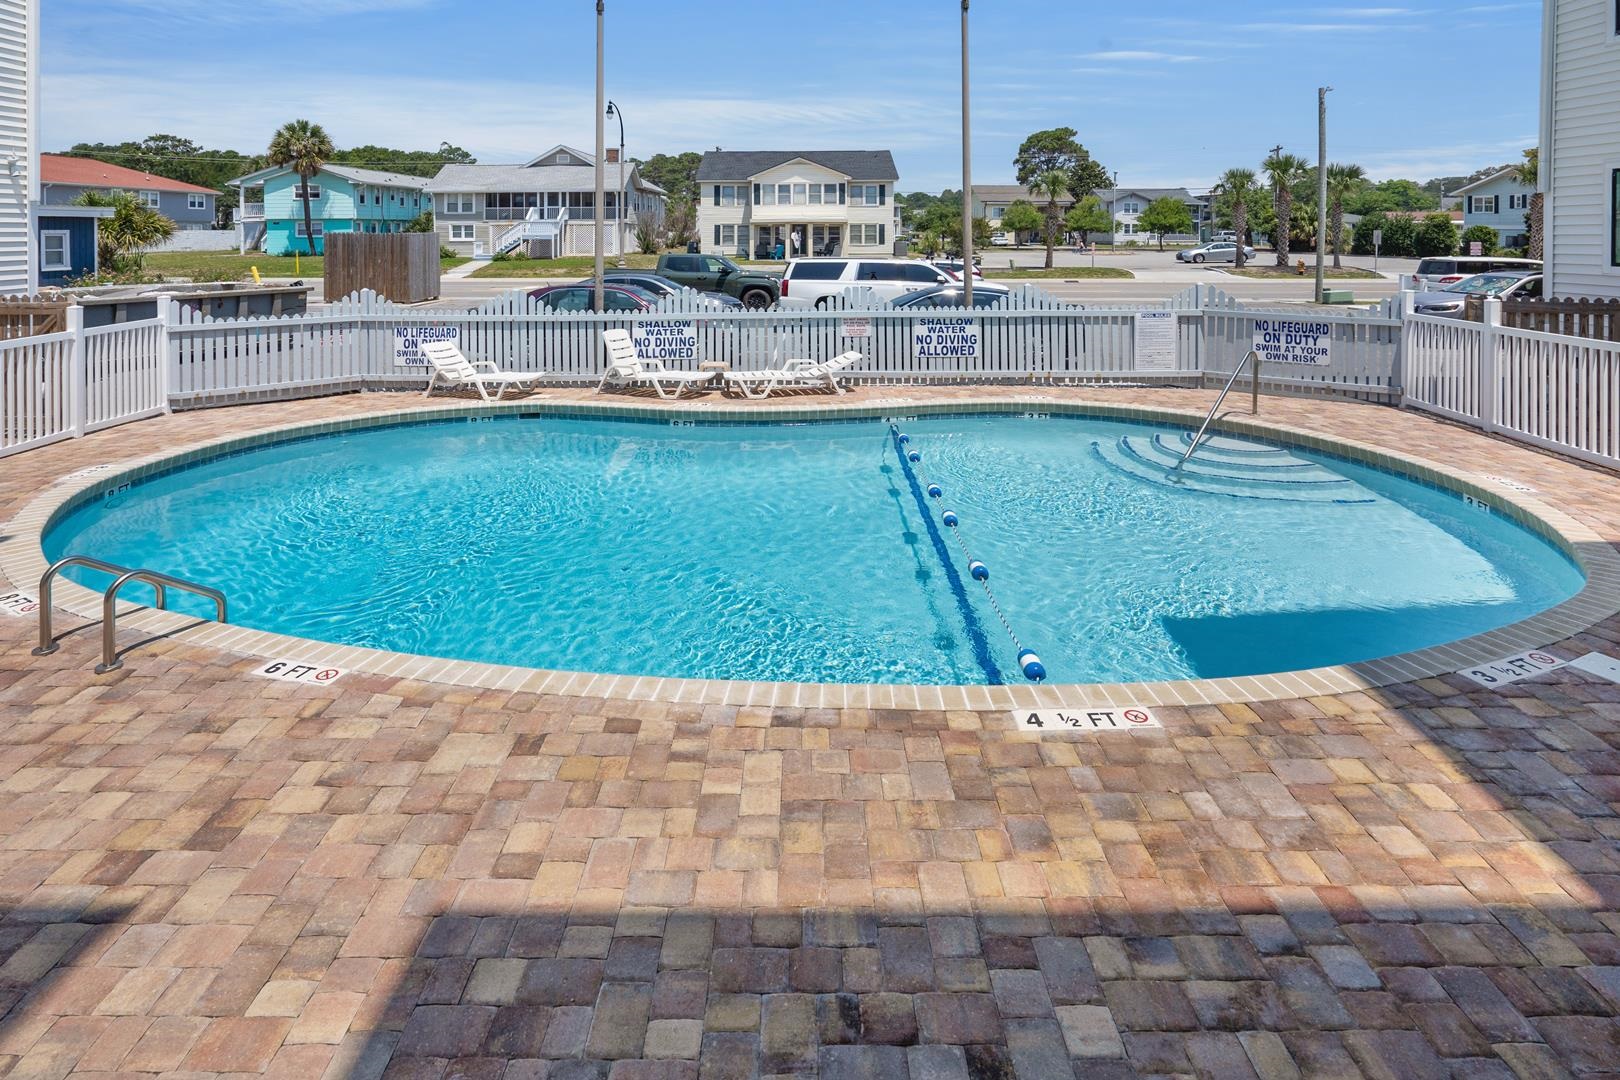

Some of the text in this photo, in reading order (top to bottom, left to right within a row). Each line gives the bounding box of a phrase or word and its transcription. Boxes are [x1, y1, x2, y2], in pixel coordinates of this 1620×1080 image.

[638, 320, 691, 328] SHALLOW
[920, 318, 974, 326] SHALLOW
[1255, 320, 1329, 335] NO LIFEGUARD
[396, 327, 457, 338] NO LIFEGUARD
[645, 328, 684, 336] WATER
[927, 326, 966, 334] WATER
[403, 339, 418, 349] ON
[634, 336, 695, 348] NO DIVING
[916, 334, 977, 345] NO DIVING
[1263, 331, 1319, 346] ON DUTY
[396, 349, 418, 357] SWIM
[637, 347, 693, 359] ALLOWED
[918, 345, 975, 356] ALLOWED
[1255, 343, 1328, 356] SWIM AT YOUR
[1265, 352, 1317, 363] OWN RISK
[4, 597, 33, 608] FT
[264, 662, 318, 679] 6 FT
[1471, 670, 1498, 683] 3
[1507, 657, 1542, 673] FT
[1026, 712, 1044, 728] 4
[1087, 712, 1117, 727] FT
